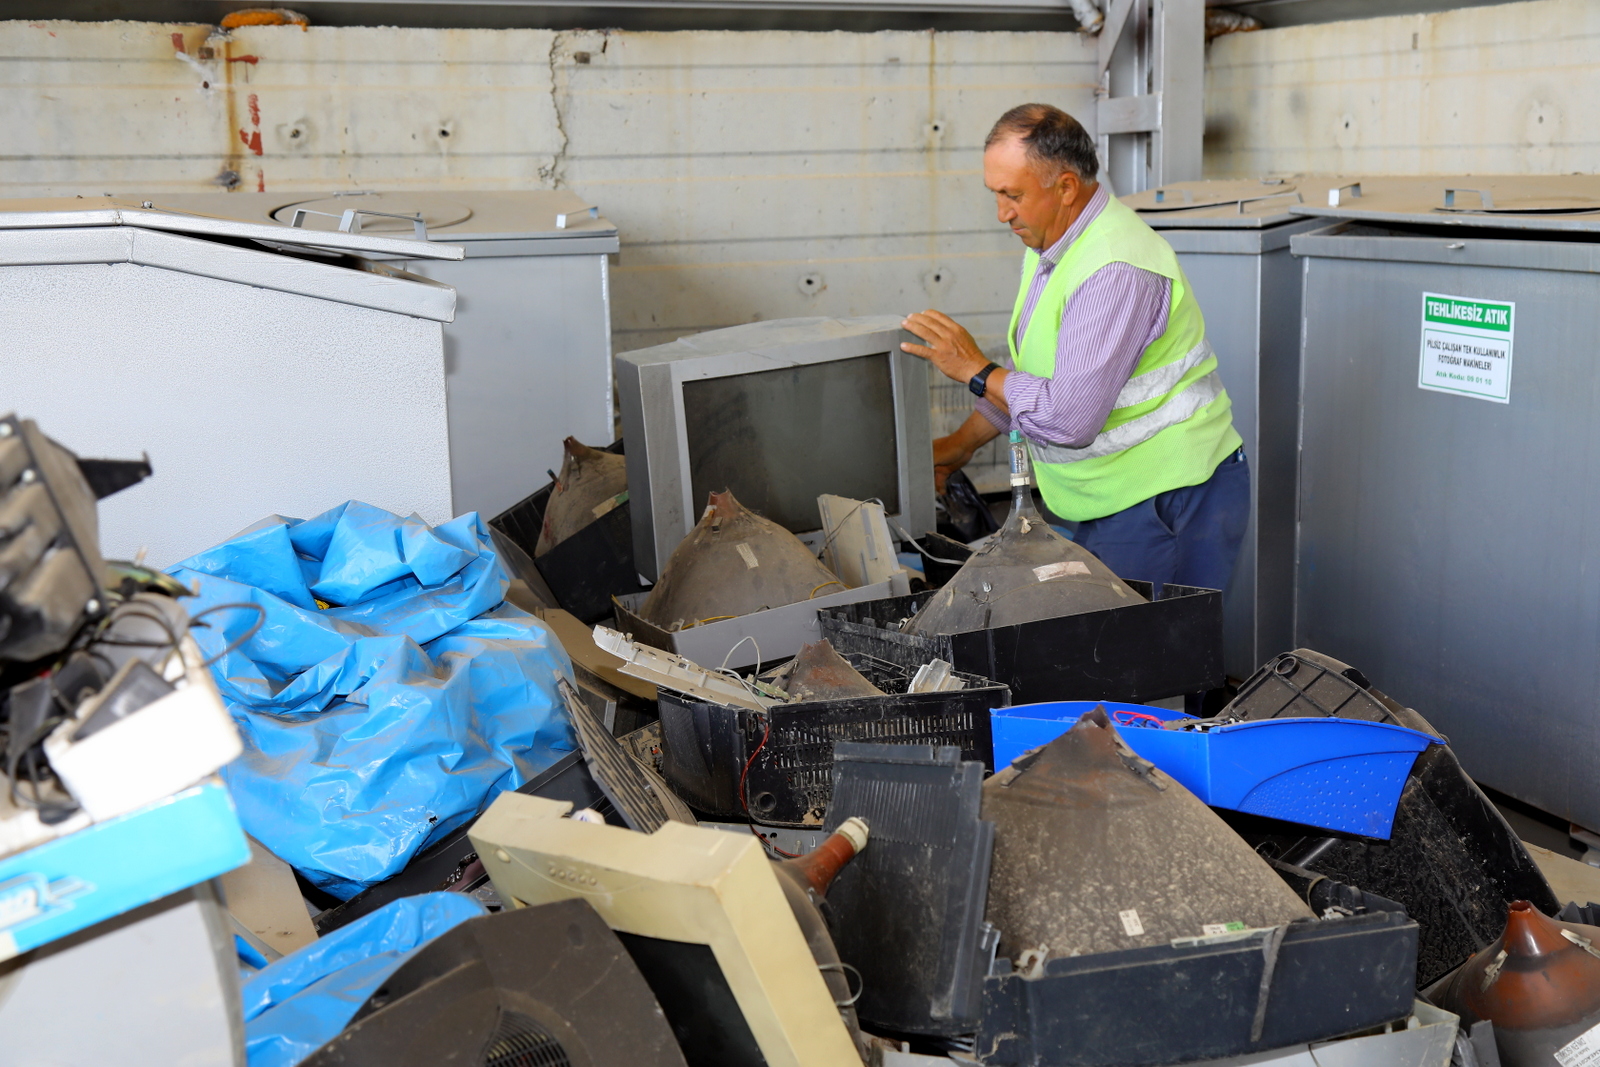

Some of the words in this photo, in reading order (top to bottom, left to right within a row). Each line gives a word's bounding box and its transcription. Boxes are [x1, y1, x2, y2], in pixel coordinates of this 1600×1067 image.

[1427, 301, 1483, 322] TEHLİKESİZ
[1484, 308, 1508, 325] ATIK
[1463, 344, 1472, 354] TEK
